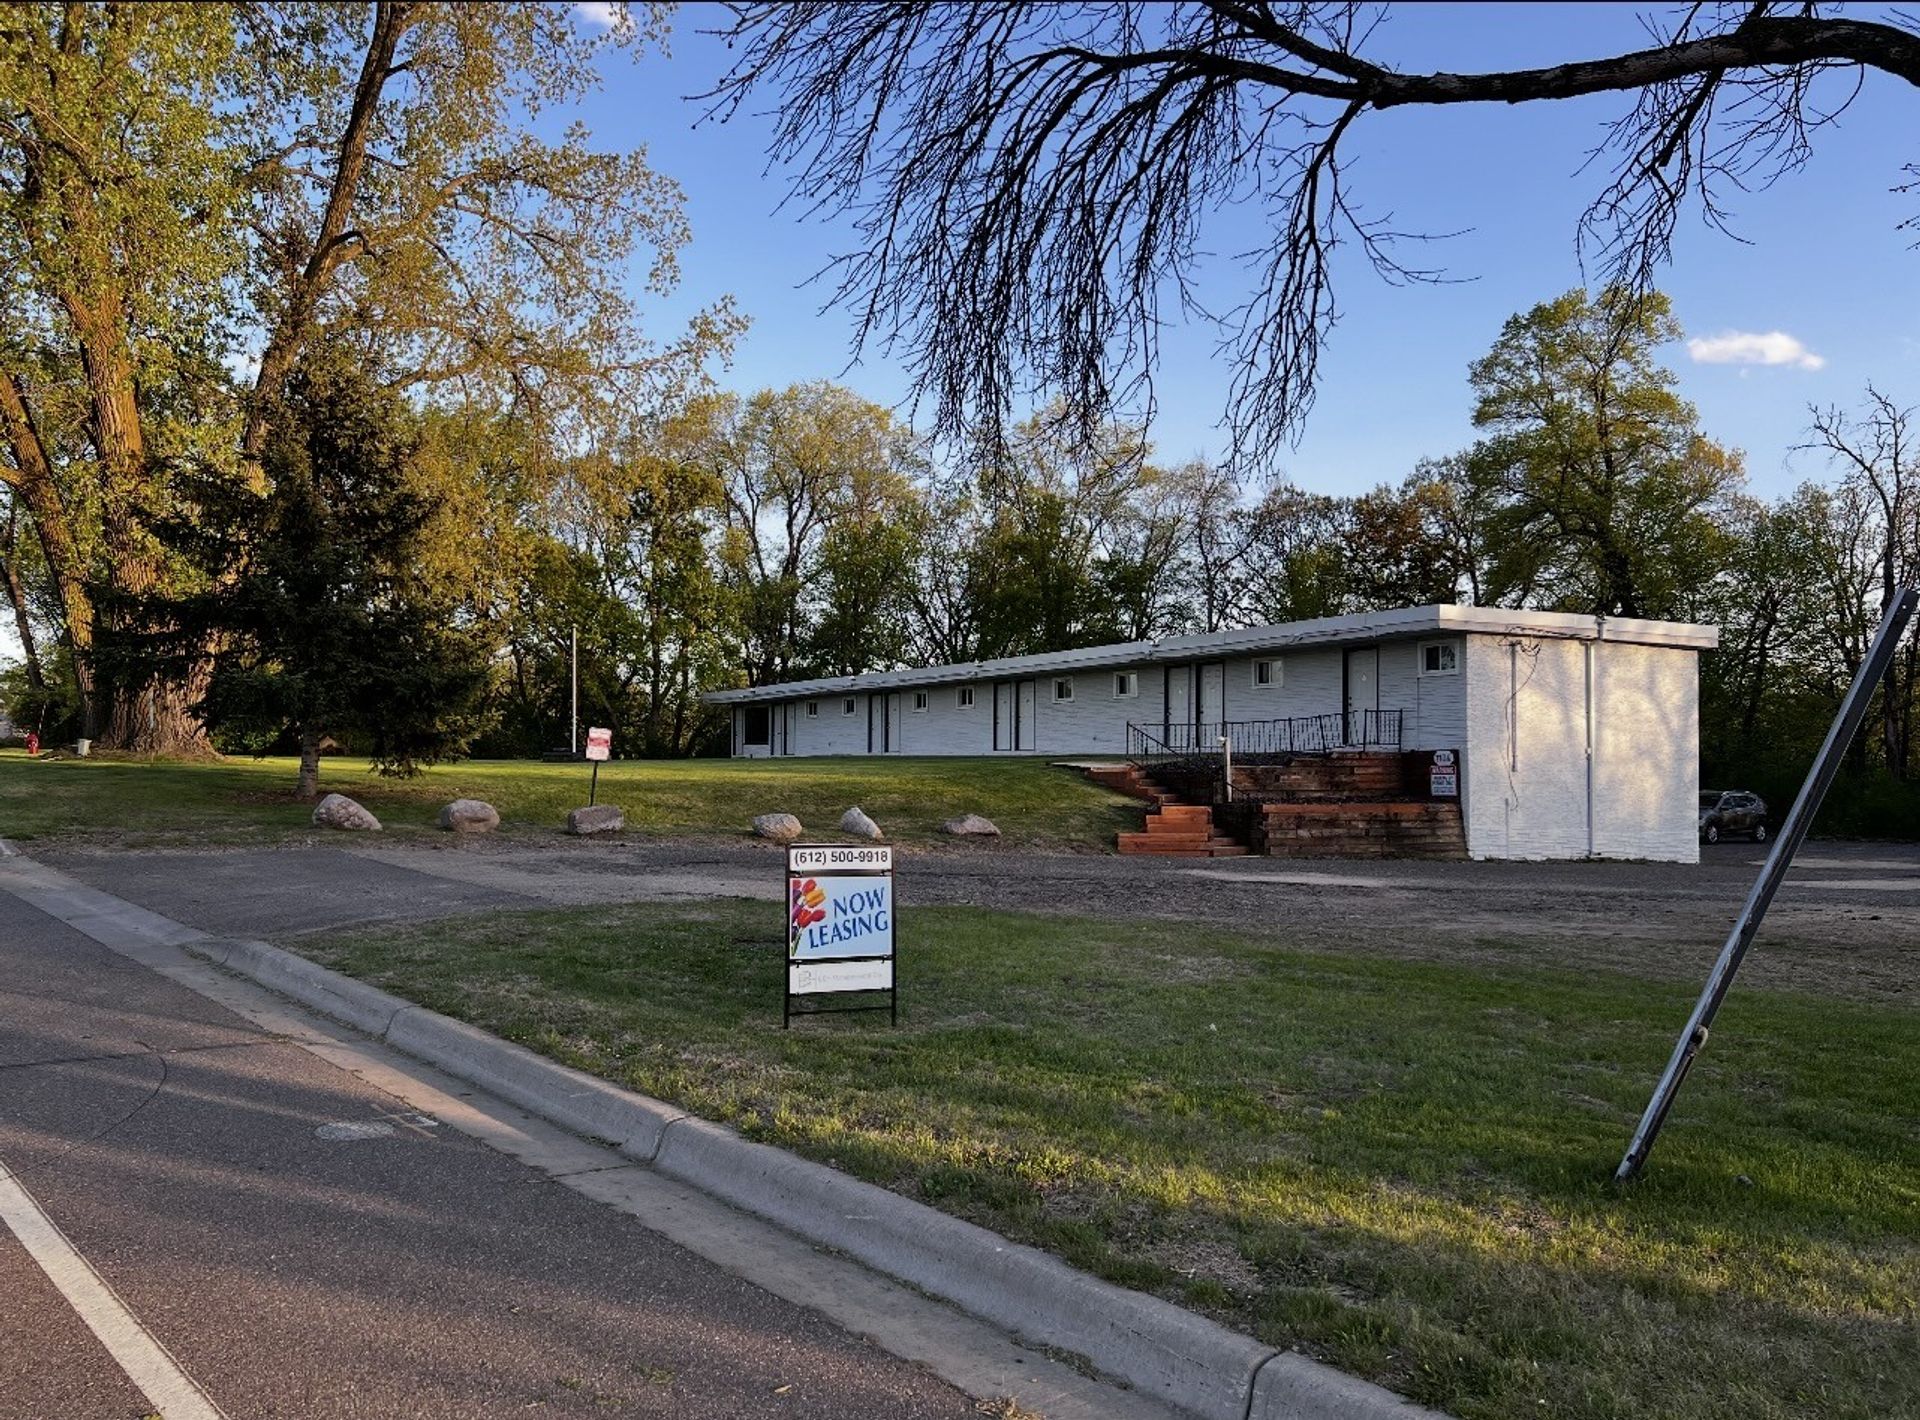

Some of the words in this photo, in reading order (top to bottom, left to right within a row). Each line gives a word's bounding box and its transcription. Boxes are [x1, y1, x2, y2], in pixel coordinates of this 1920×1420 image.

[795, 851, 827, 866] (612)
[831, 851, 888, 863] 500-9918
[833, 887, 885, 918] NOW
[809, 910, 888, 949] LEASING
